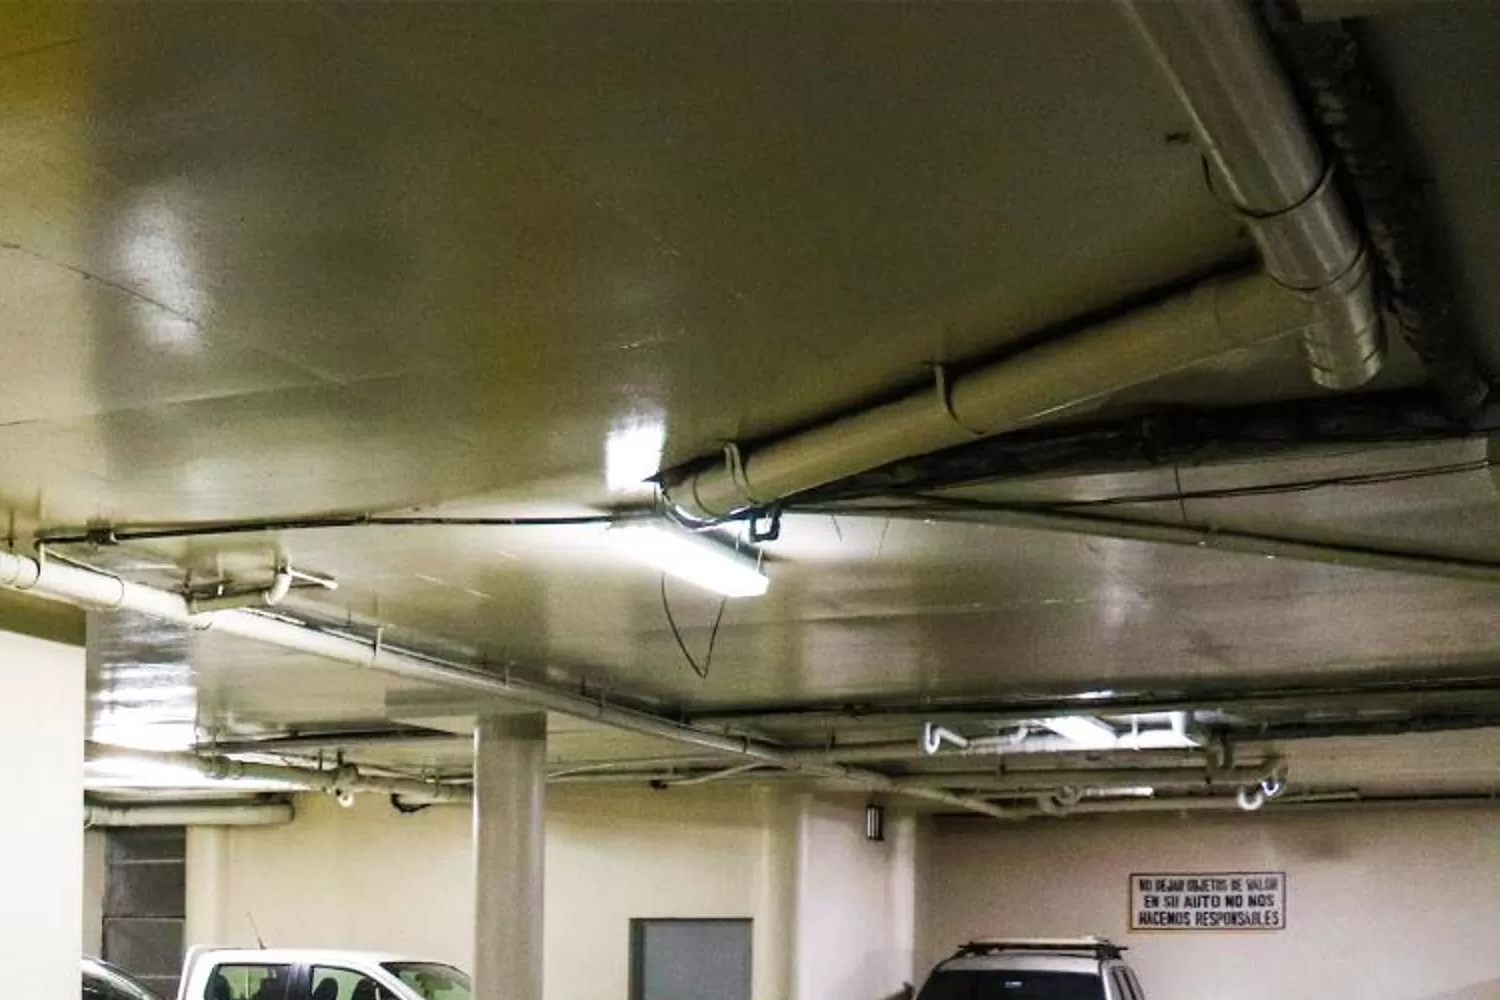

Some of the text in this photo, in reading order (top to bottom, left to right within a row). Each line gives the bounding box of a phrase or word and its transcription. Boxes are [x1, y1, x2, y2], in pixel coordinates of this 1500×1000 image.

[1138, 878, 1153, 892] NO
[1231, 878, 1242, 892] DE
[1143, 893, 1276, 909] EN SU AUTO NO NOS
[1138, 911, 1279, 926] HACEMOS RESPONSABLES
